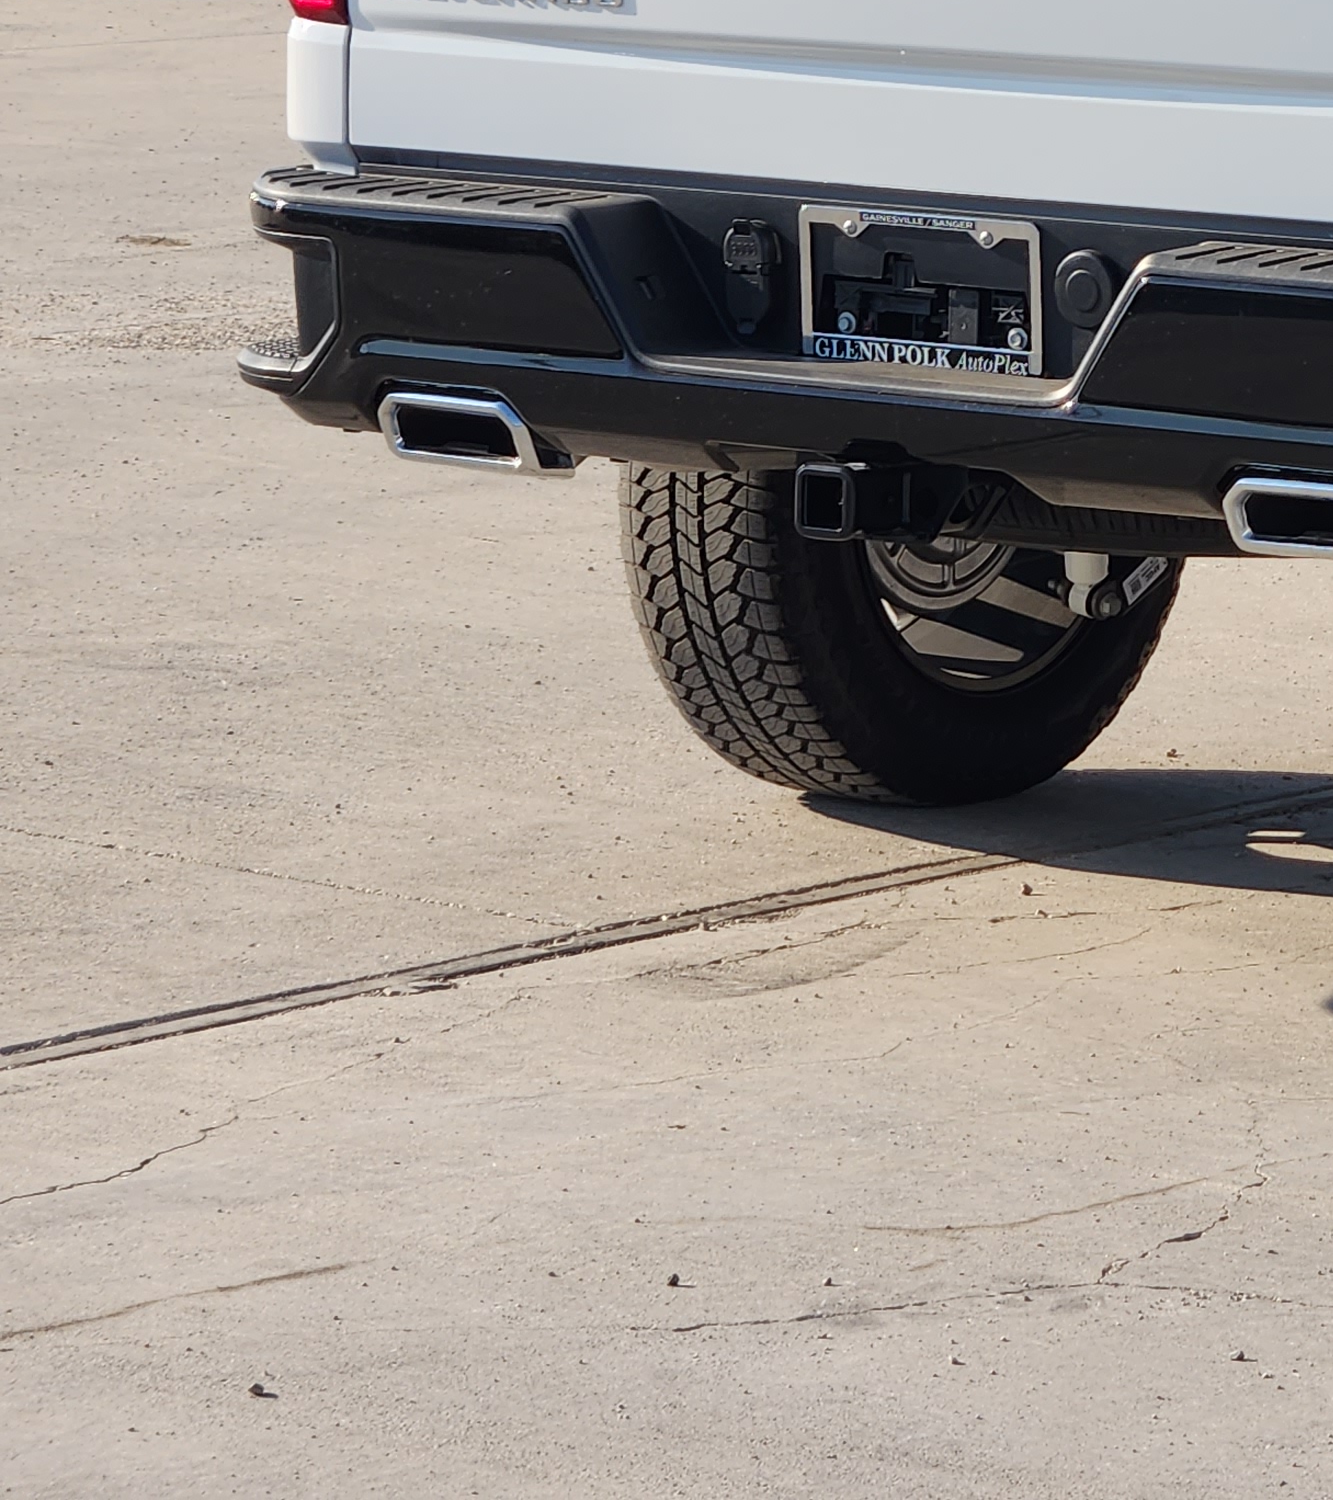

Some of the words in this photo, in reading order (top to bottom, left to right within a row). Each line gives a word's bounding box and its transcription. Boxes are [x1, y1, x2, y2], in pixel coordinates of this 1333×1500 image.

[861, 212, 924, 227] GAINESVILLE
[931, 219, 974, 230] SANGER
[815, 337, 889, 363] GLENN
[891, 345, 951, 368] POLK
[954, 350, 1028, 376] AutoPlex
